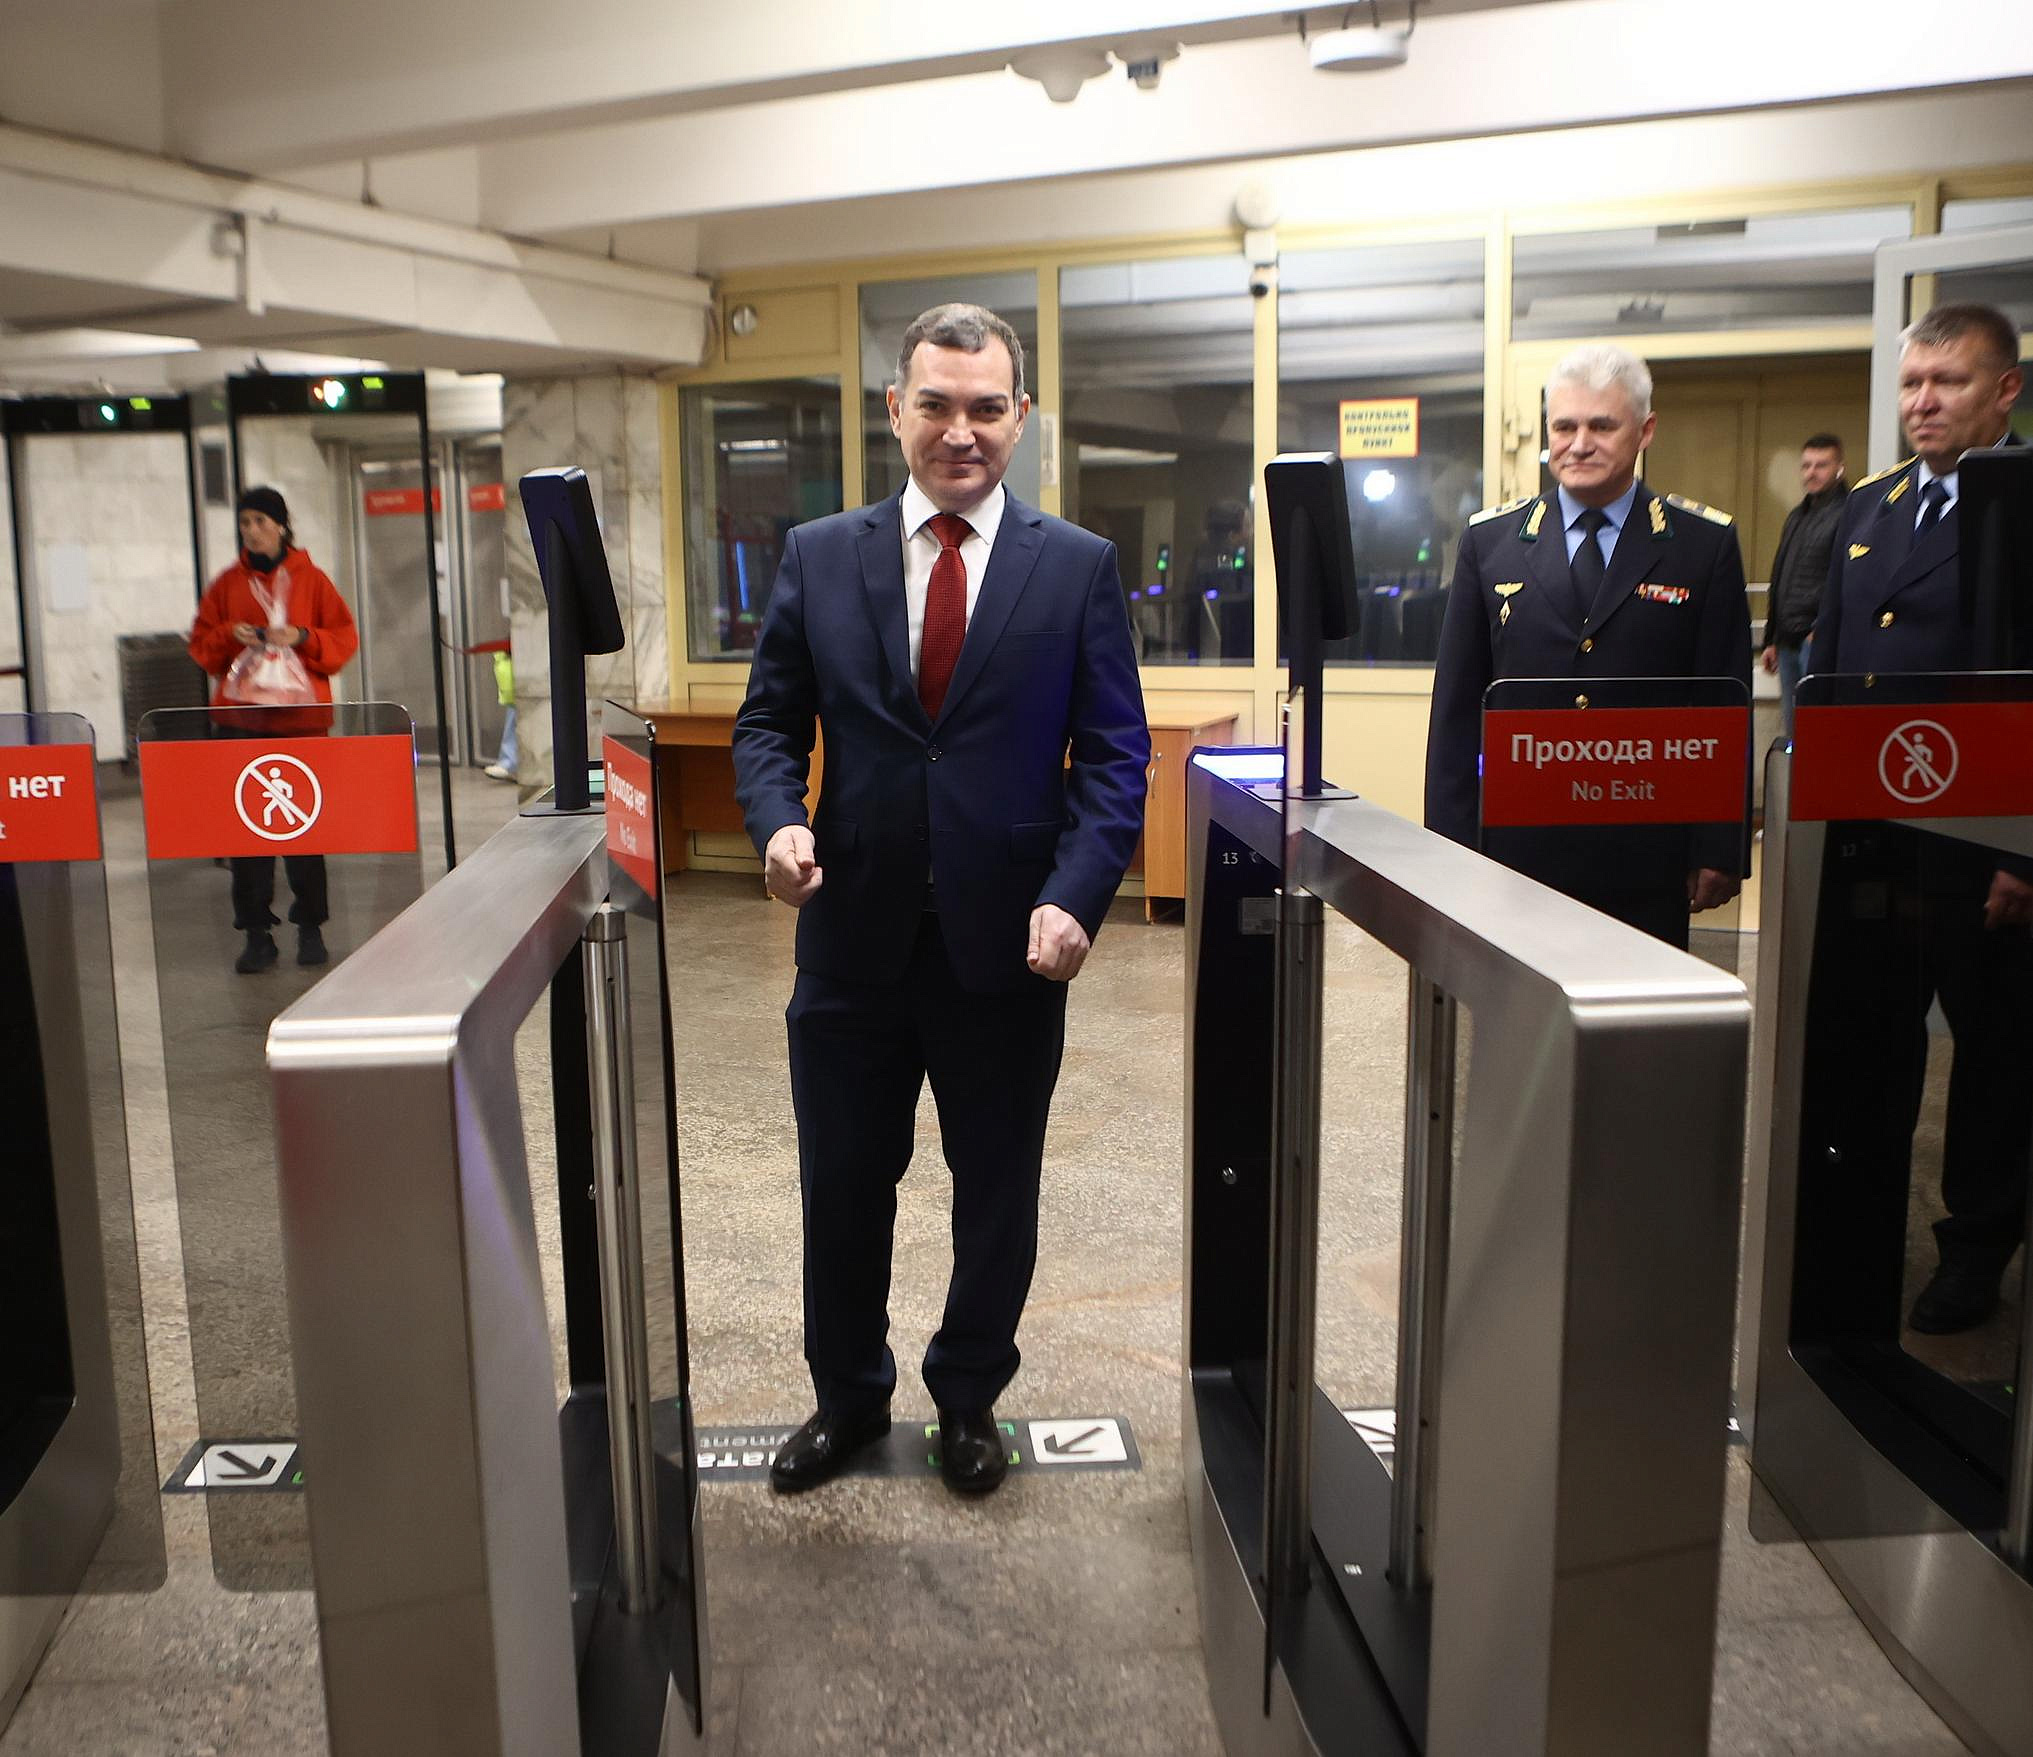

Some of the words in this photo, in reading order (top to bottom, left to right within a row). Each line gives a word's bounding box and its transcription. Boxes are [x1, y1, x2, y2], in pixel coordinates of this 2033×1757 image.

[1511, 733, 1653, 770] Прохода
[1663, 738, 1719, 760] нет
[8, 775, 65, 799] нет
[1571, 780, 1604, 801] No
[1611, 779, 1655, 800] Exit
[1222, 852, 1239, 865] 13
[700, 1431, 792, 1449] yment
